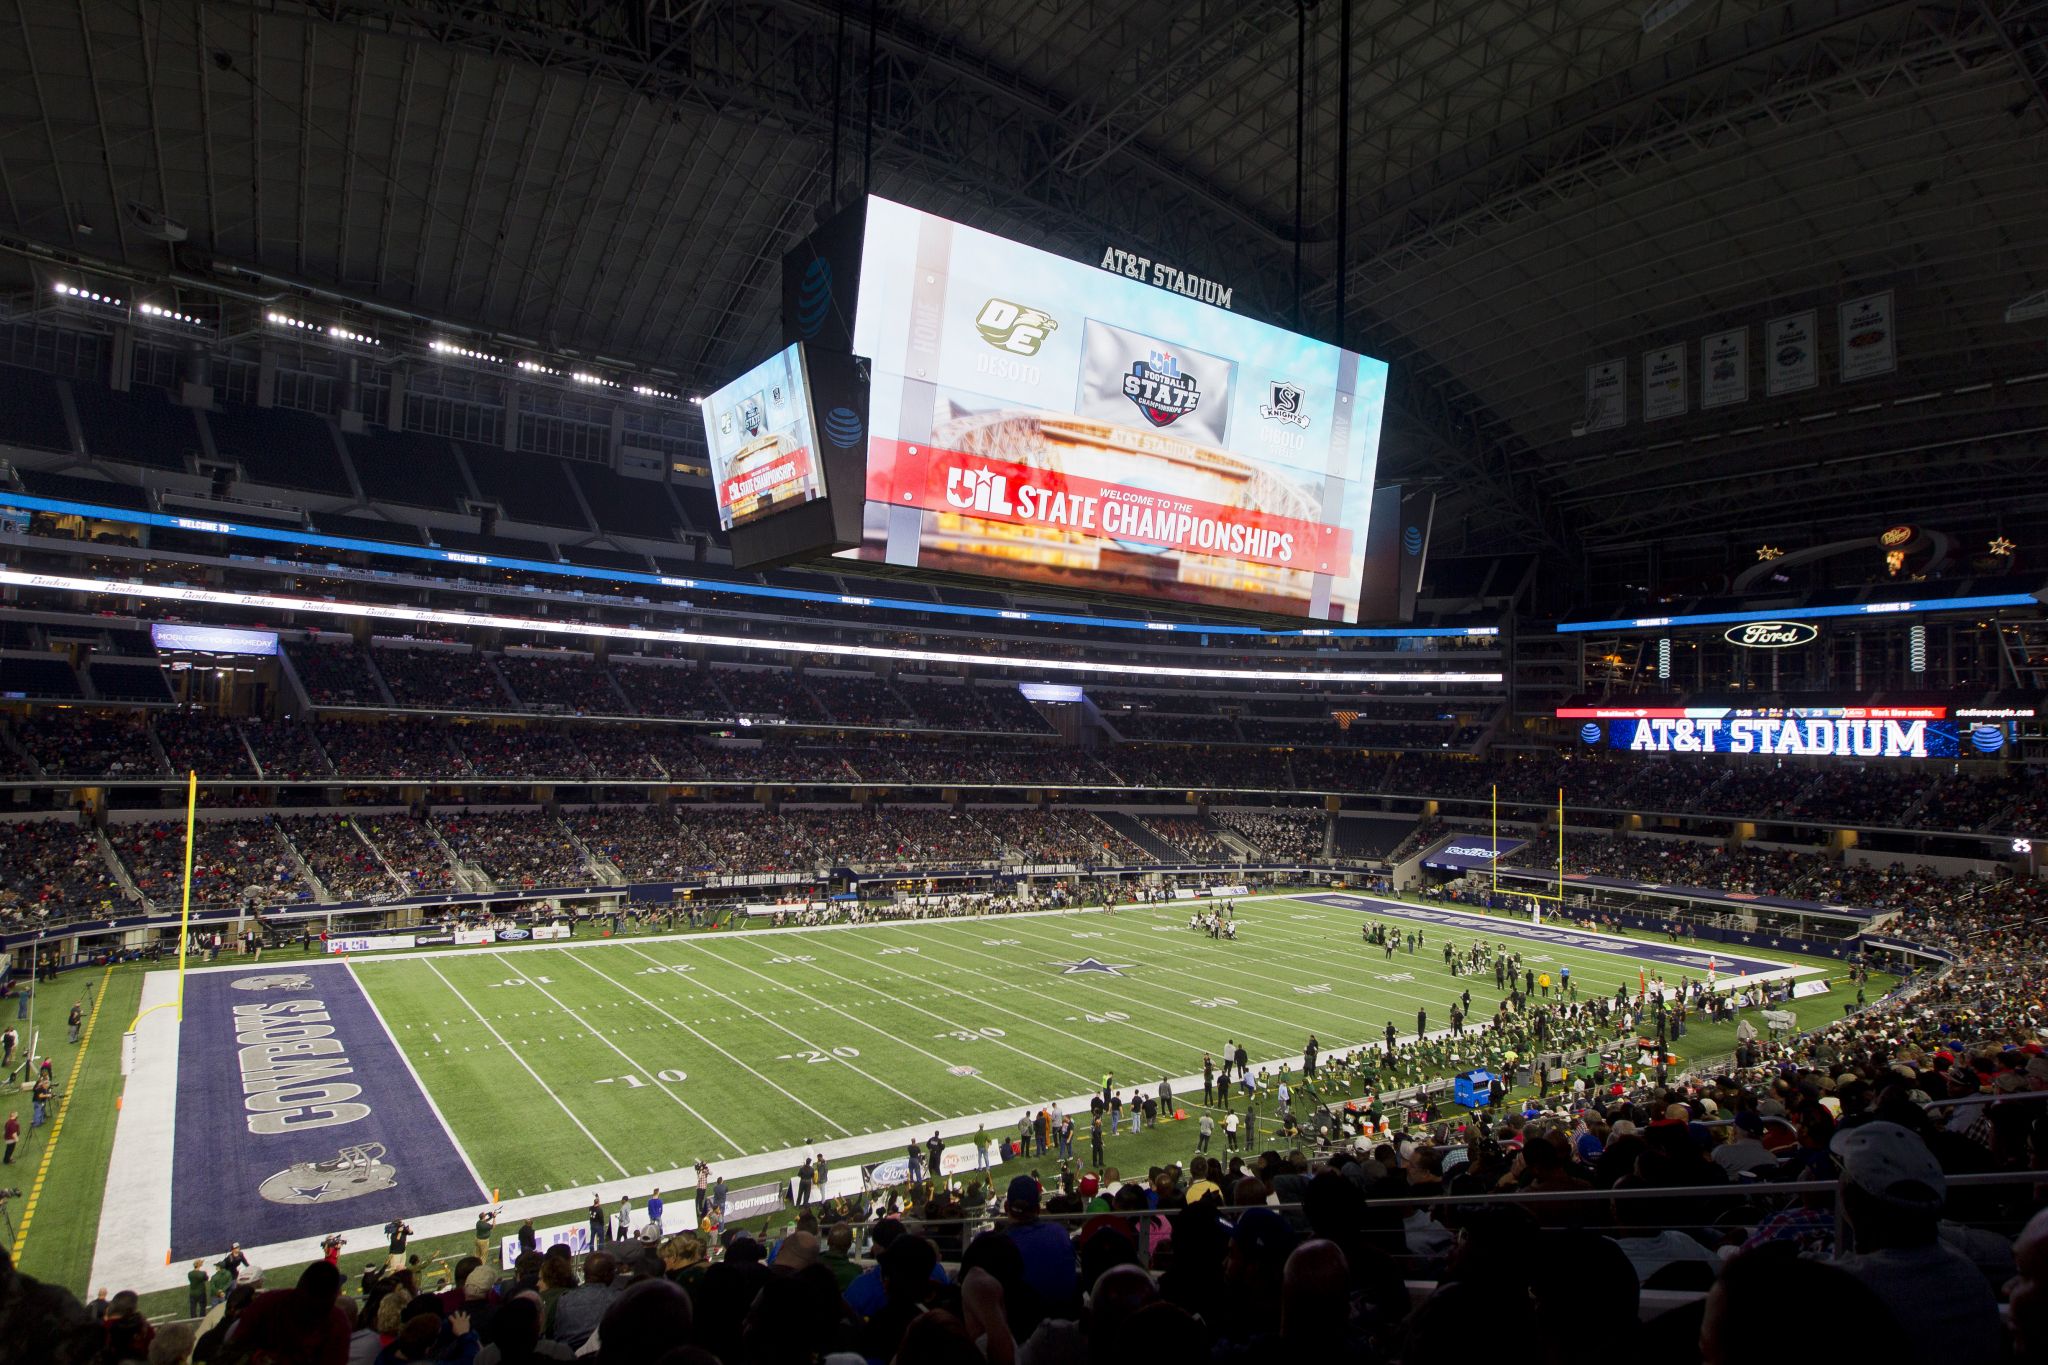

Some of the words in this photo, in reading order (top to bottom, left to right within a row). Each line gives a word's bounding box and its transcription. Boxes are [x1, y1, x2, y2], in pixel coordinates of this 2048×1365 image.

[1101, 246, 1150, 280] AT&T
[1153, 264, 1232, 309] STADIUM
[1144, 371, 1186, 389] FOOTBALL
[1124, 376, 1200, 409] STATE
[1138, 398, 1182, 414] CHAMPIONSHIPS
[1268, 410, 1302, 424] KNIGHTS
[1100, 487, 1154, 506] WELCOME
[1157, 499, 1171, 509] TO
[1173, 501, 1193, 514] THE
[179, 518, 217, 532] WELCOME
[218, 523, 229, 532] TO
[1016, 486, 1098, 530] STATE
[1102, 501, 1294, 562] CHAMPIONSHIPS
[448, 552, 477, 562] WELCOME
[478, 556, 487, 564] TO
[30, 576, 71, 588] Baden
[105, 583, 142, 595] Baden
[182, 590, 216, 602] Baden
[242, 596, 274, 606] Baden
[302, 602, 334, 612] Baden
[366, 607, 396, 617] Baden
[1867, 602, 1899, 612] WELCOME
[1900, 602, 1910, 610] TO
[1636, 618, 1659, 627] WELCOME
[1660, 618, 1669, 626] TO
[1743, 624, 1798, 644] Ford
[233, 639, 272, 648] GAMEDAY
[1956, 709, 2034, 718] stadiumpeople.com
[1630, 718, 1722, 752] AT&T
[1730, 718, 1928, 758] STADIUM
[1023, 865, 1034, 874] ARE
[1035, 864, 1055, 874] KNIGHT
[1056, 864, 1076, 873] NATION
[721, 876, 733, 887] WE
[734, 875, 748, 886] ARE
[749, 874, 774, 885] KNIGHT
[775, 873, 800, 884] NATION
[506, 930, 522, 939] Ford
[504, 976, 556, 986] 10
[1190, 997, 1239, 1008] 50
[1085, 1011, 1131, 1024] 40
[950, 1027, 1006, 1042] 30
[797, 1046, 860, 1064] 20
[232, 1000, 372, 1134] COWBOYS
[614, 1069, 689, 1090] 10
[734, 1194, 780, 1211] SOUTHWEST
